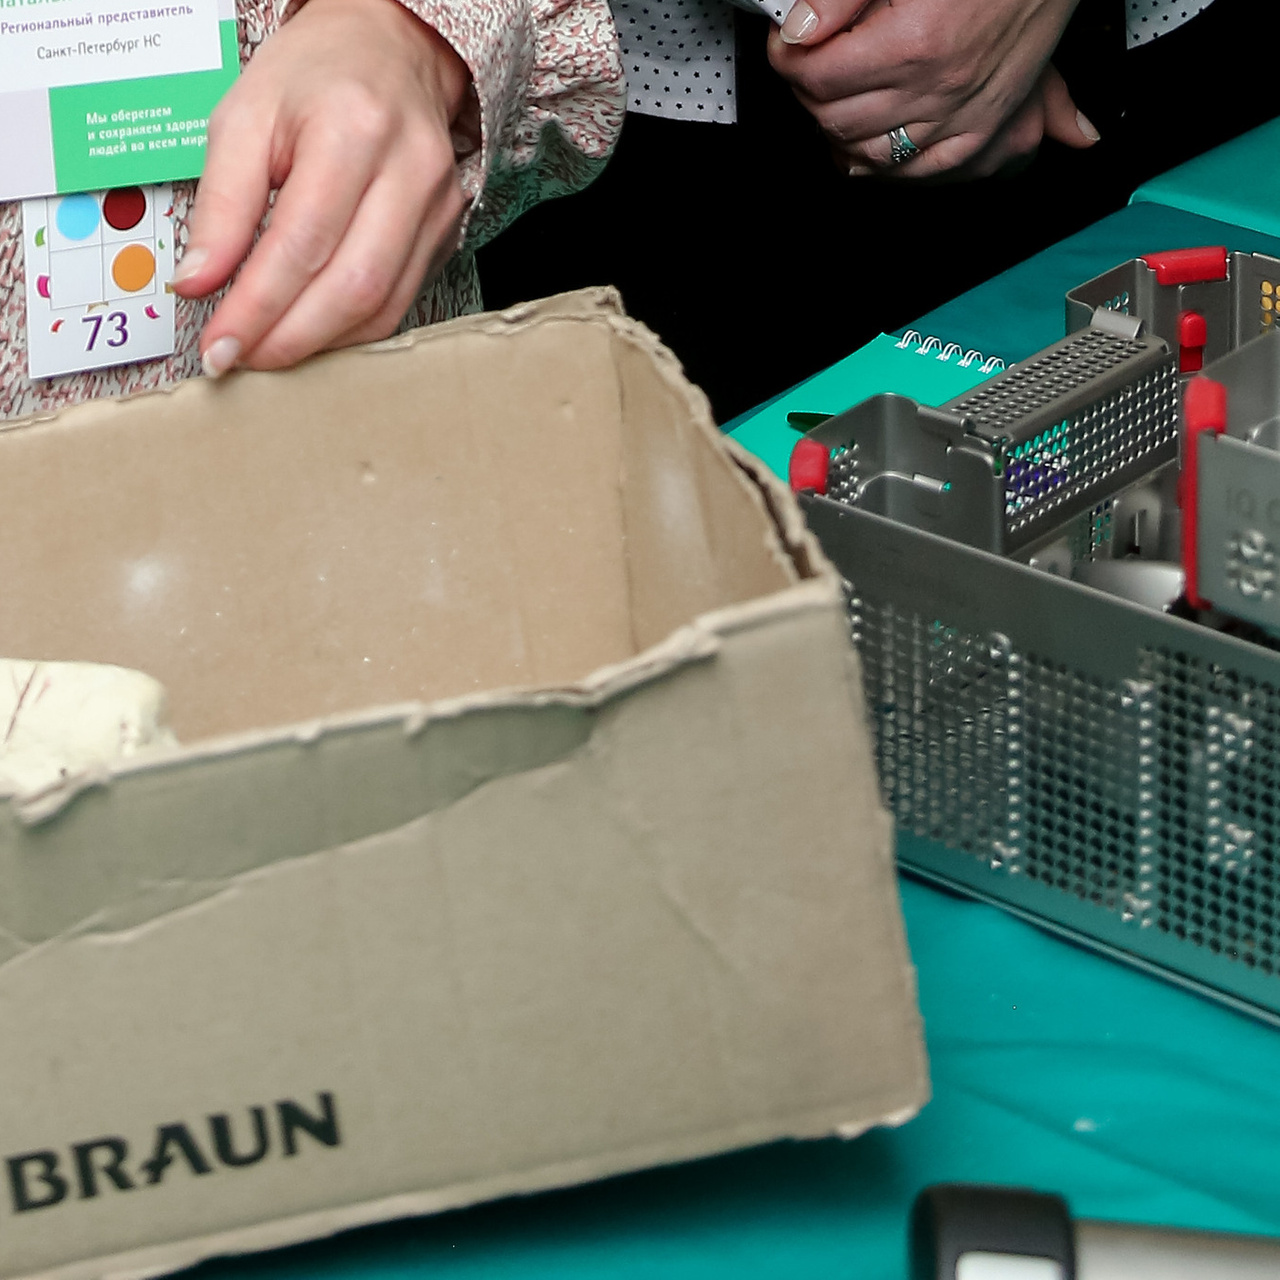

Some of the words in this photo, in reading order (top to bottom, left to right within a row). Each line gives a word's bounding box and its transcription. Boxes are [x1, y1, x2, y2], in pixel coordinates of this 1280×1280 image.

[0, 12, 93, 35] Региональный
[98, 4, 194, 27] представитель
[37, 38, 140, 59] Санкт-Петербург
[86, 111, 108, 125] Мы
[111, 107, 172, 122] оберегаем
[87, 132, 95, 140] и
[99, 124, 162, 139] сохраняем
[166, 119, 209, 133] здоров
[89, 141, 127, 157] людей
[131, 142, 145, 152] во
[148, 138, 177, 150] всем
[82, 311, 128, 351] 73
[5, 1090, 342, 1215] BRAUN
